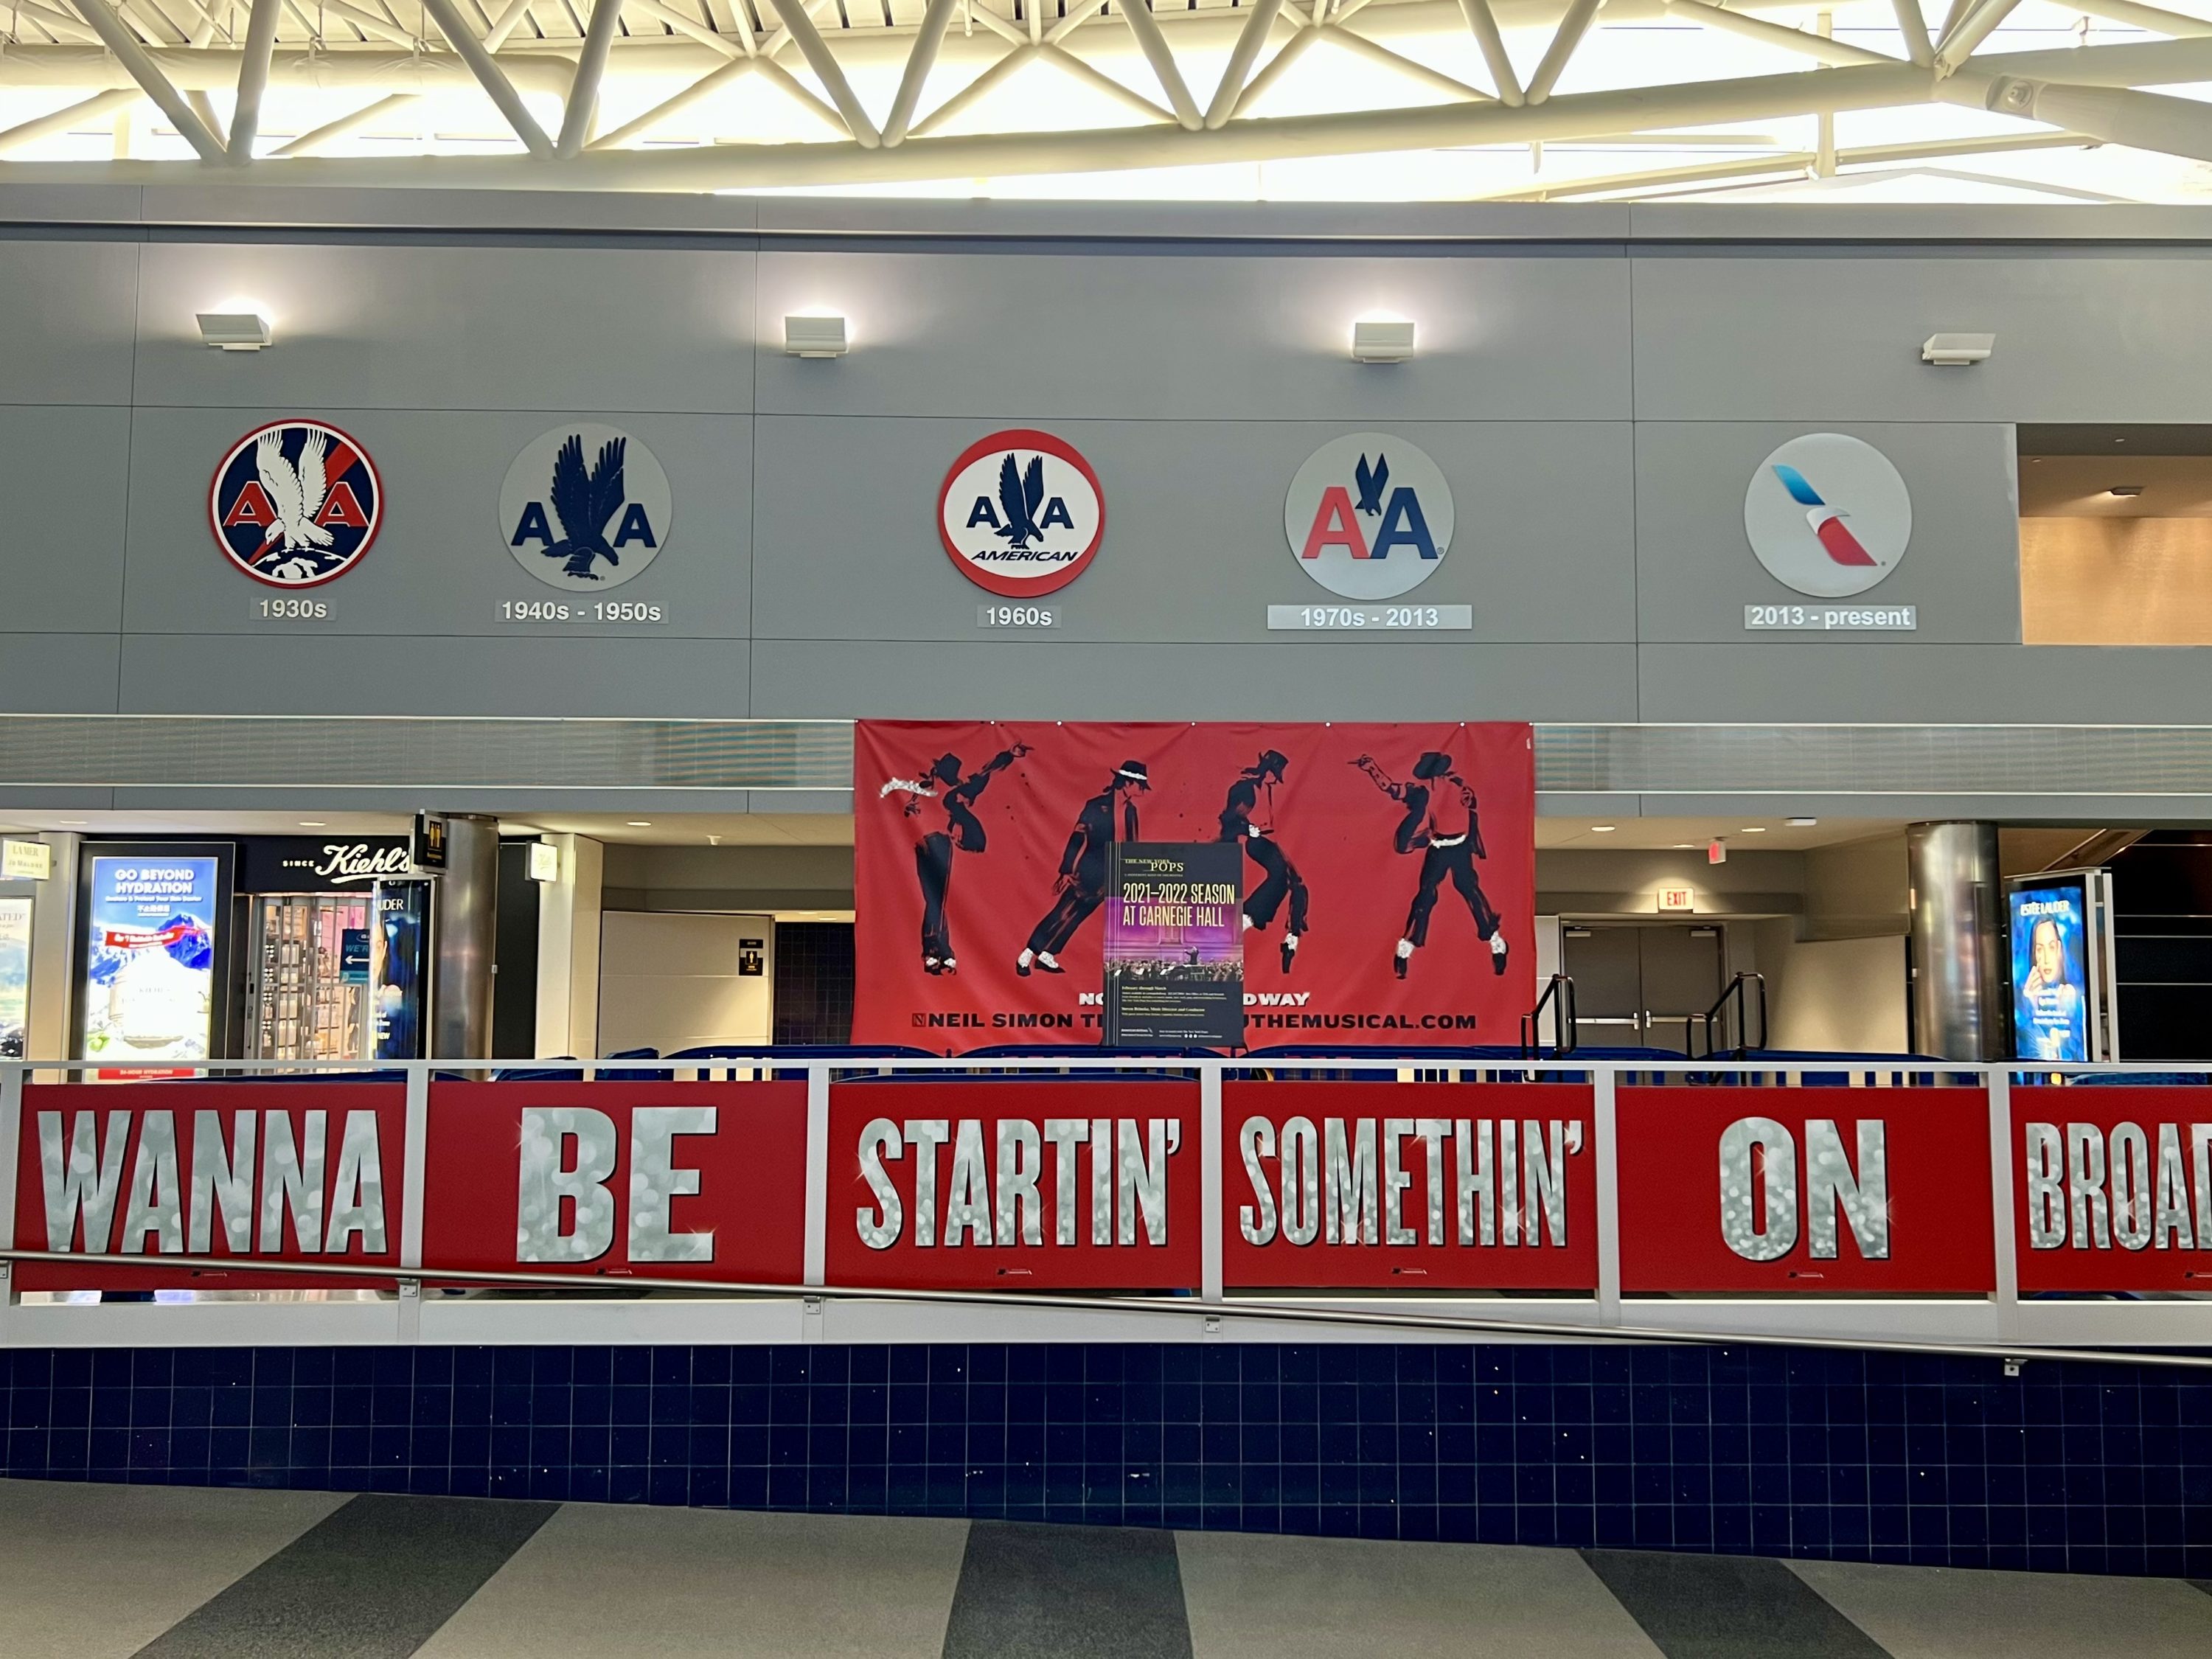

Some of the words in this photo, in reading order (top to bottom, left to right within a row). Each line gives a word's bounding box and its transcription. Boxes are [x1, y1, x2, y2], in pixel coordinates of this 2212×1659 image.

[223, 481, 278, 527] A
[314, 481, 369, 527] A
[966, 496, 1001, 529] A
[1040, 497, 1074, 529] A
[511, 501, 554, 546] A
[613, 503, 658, 548] A
[970, 551, 1078, 562] AMERICAN
[259, 599, 327, 619] 1930s
[501, 601, 570, 620] 1940s
[593, 602, 662, 622] 1950s
[985, 607, 1053, 627] 1960s
[1300, 608, 1366, 627] 1970s
[1385, 608, 1439, 627] 2013
[1750, 607, 1805, 626] 2013
[1825, 607, 1910, 630] present
[315, 844, 410, 877] Kiehl's
[1150, 862, 1184, 872] POPS
[115, 869, 139, 880] GO
[141, 869, 195, 881] BEYOND
[115, 882, 194, 894] HYDRATION
[1191, 883, 1235, 905] SEASON
[378, 899, 404, 911] UDER
[1666, 891, 1686, 906] EXIT
[1123, 905, 1136, 926] AT
[1139, 905, 1193, 927] CARNEGIE
[1197, 906, 1225, 927] HALL
[345, 944, 369, 953] WE'R
[1242, 992, 1310, 1006] DWAY
[928, 1013, 985, 1027] NEIL
[992, 1013, 1073, 1028] SIMON
[1243, 1014, 1477, 1029] THEMUSICAL.COM
[37, 1109, 388, 1255] WANNA
[515, 1106, 718, 1264] BE
[855, 1117, 1180, 1250] STARTIN'
[1239, 1116, 1584, 1248] SOMETHIN'
[1719, 1116, 1890, 1262] ON
